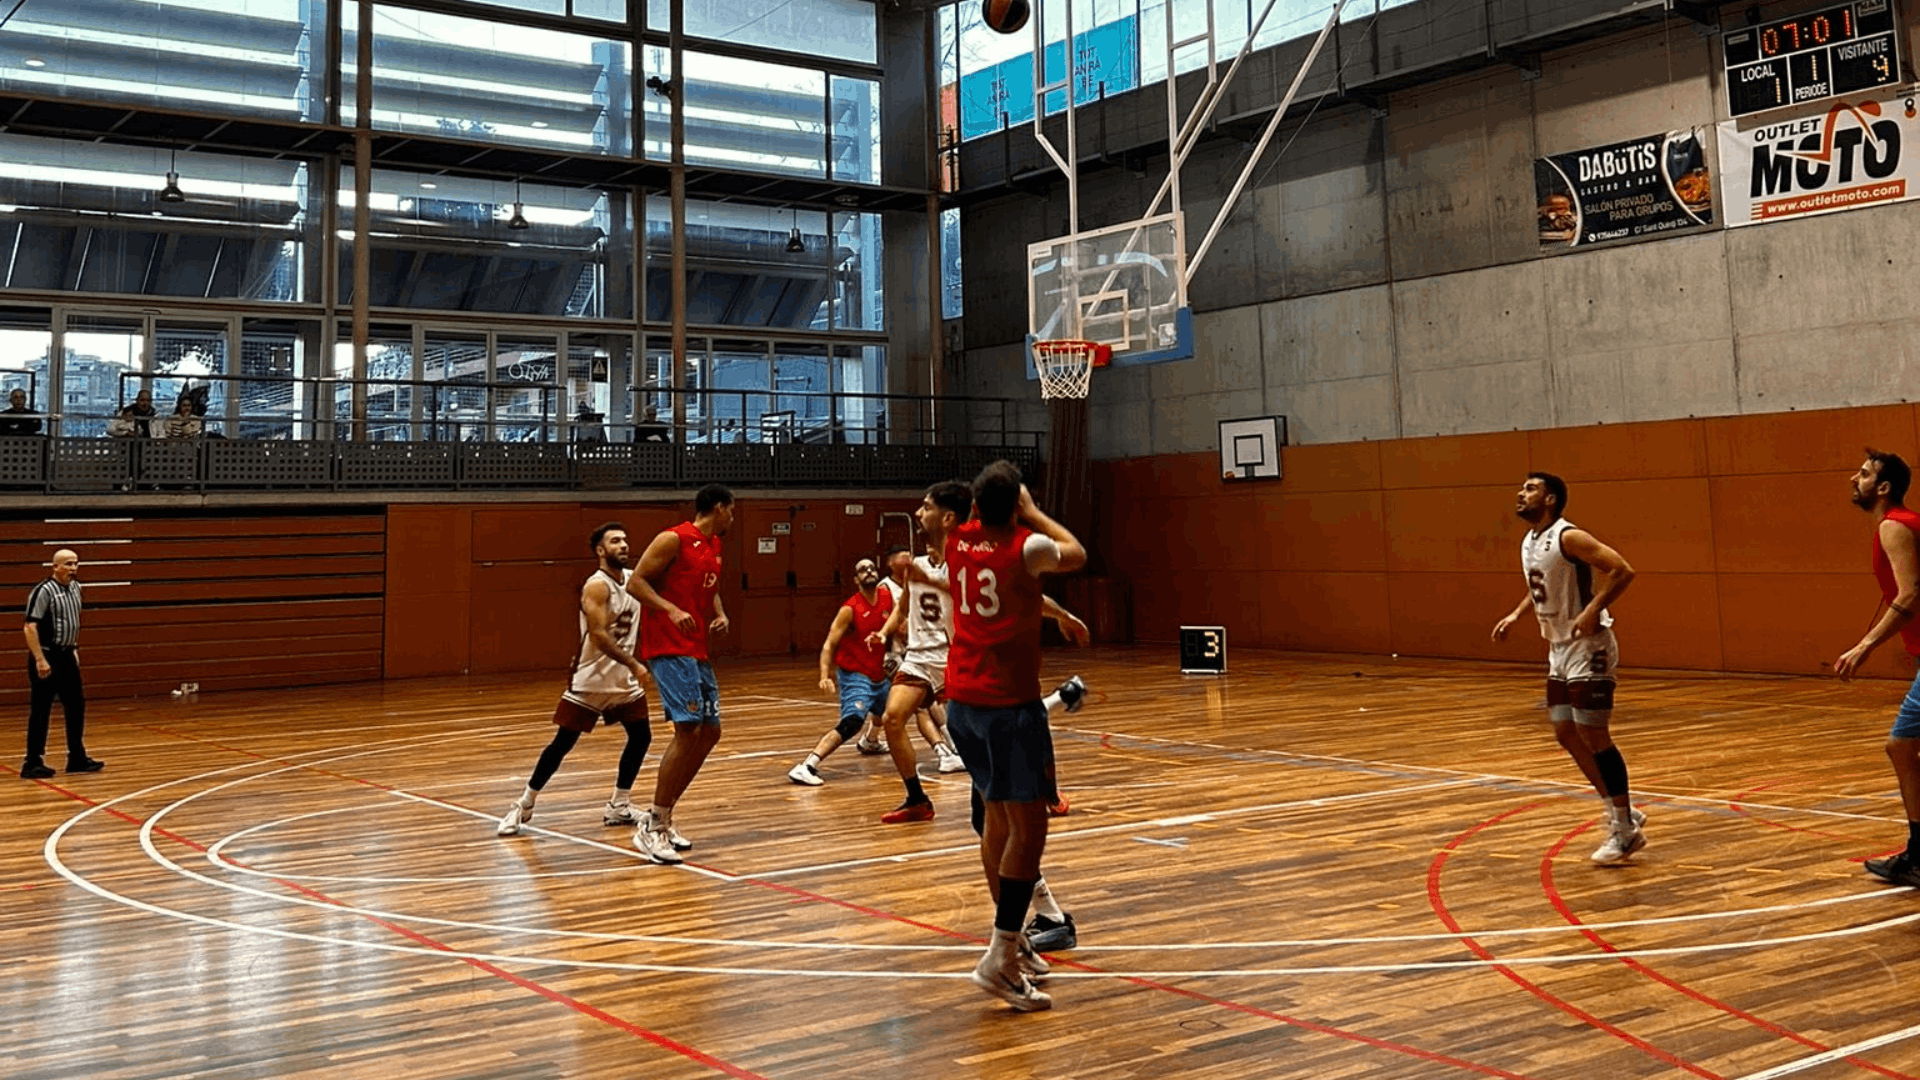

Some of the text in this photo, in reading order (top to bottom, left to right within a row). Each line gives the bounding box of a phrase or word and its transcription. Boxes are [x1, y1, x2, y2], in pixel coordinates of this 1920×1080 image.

[1763, 9, 1852, 54] 07:01
[1837, 37, 1889, 61] VISITANTE
[1741, 64, 1776, 82] LOCAL
[1811, 55, 1818, 81] 1
[1775, 77, 1782, 103] 1
[1795, 82, 1828, 100] PERIODE
[1754, 118, 1821, 142] OUTLET
[1750, 120, 1901, 198] MOTO
[1580, 183, 1619, 196] GASTRO
[1638, 174, 1658, 185] BAR
[1609, 200, 1674, 220] PARA GRUPOS
[1614, 193, 1655, 209] PRIVADO
[1767, 183, 1901, 214] www.outletmoto.com
[957, 566, 1000, 617] 13
[1204, 631, 1219, 657] 3
